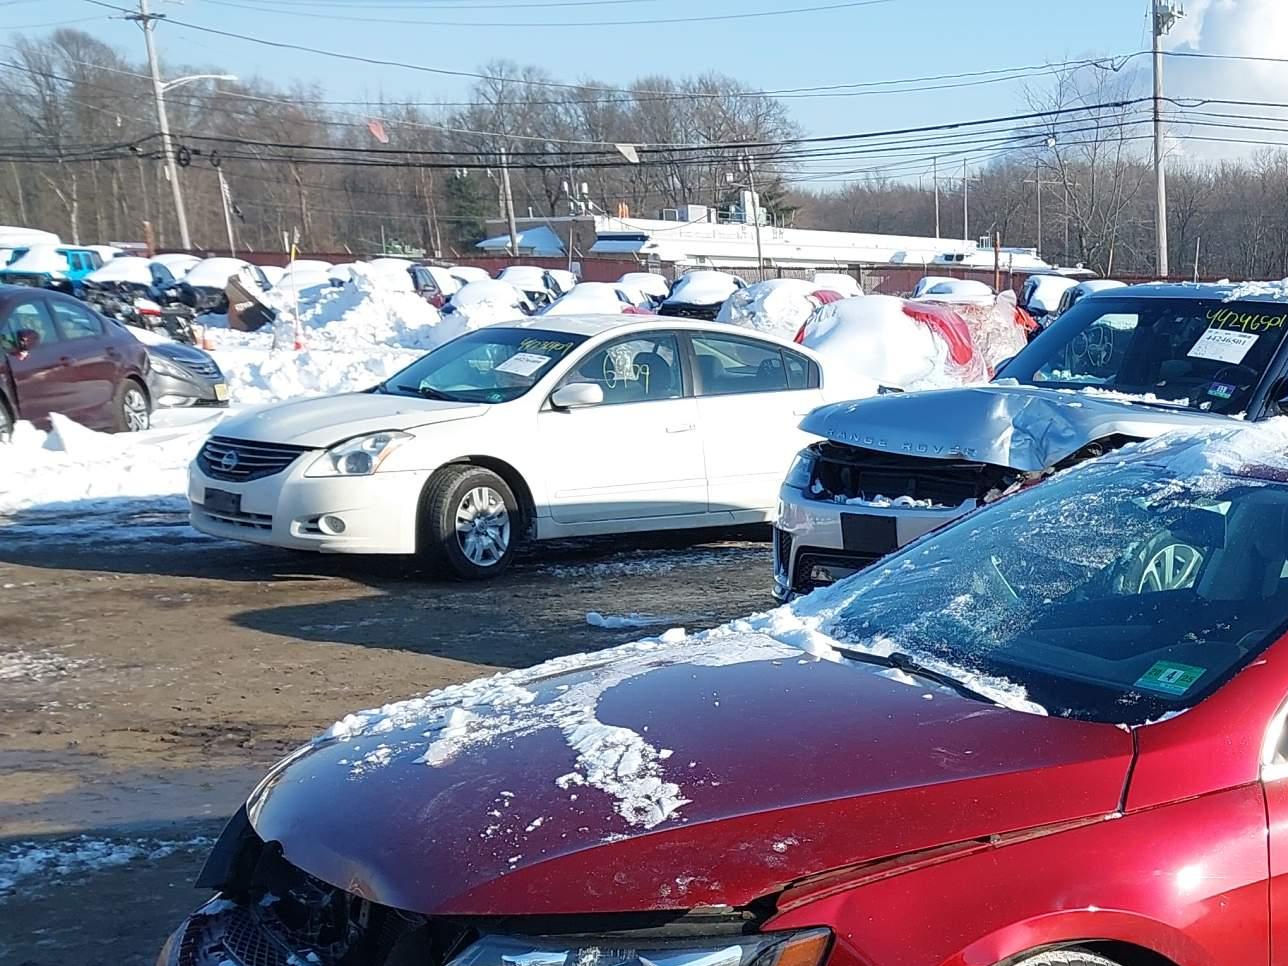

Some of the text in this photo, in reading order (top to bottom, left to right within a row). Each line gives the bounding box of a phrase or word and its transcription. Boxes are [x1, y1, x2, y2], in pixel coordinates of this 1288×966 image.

[1206, 308, 1288, 332] 44246501
[826, 429, 978, 457] RANGE ROVER
